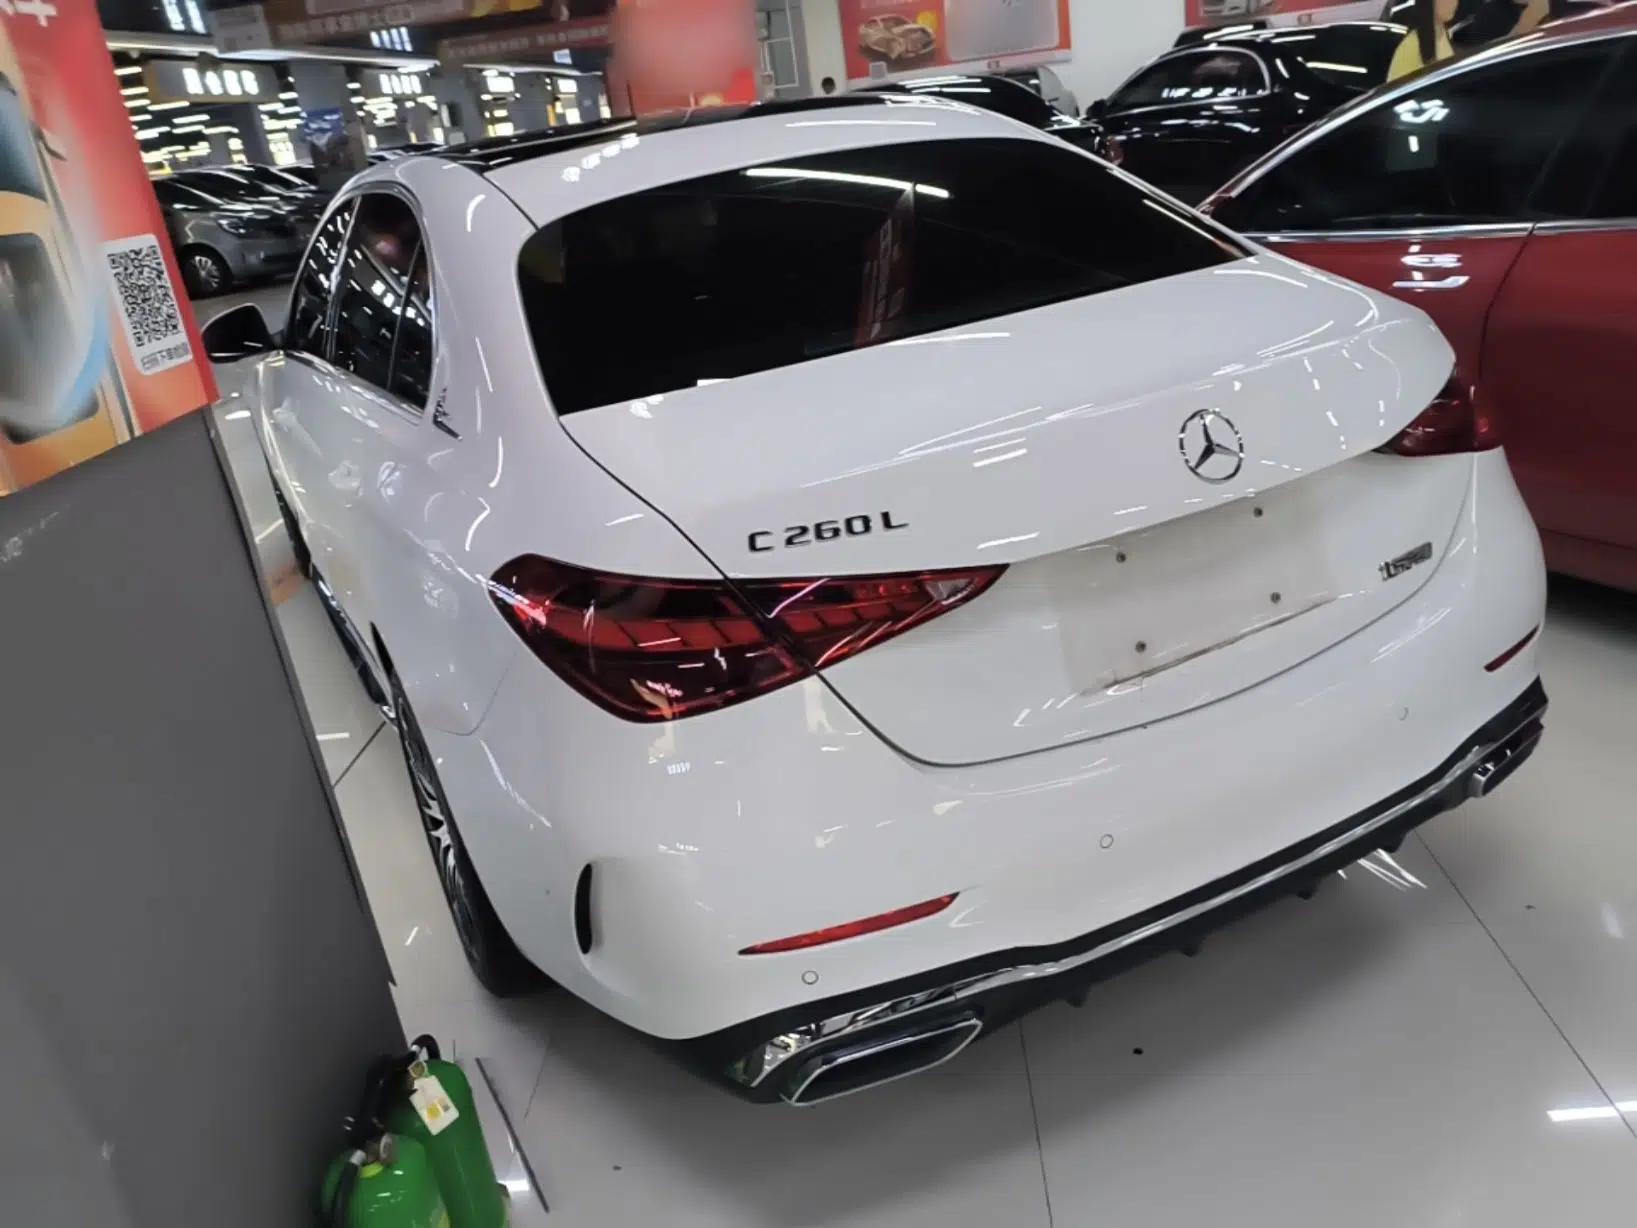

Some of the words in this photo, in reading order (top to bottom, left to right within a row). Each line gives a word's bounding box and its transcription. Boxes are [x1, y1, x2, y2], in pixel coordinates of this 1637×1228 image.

[748, 531, 774, 552] C
[784, 514, 872, 547] 260
[880, 511, 909, 530] L
